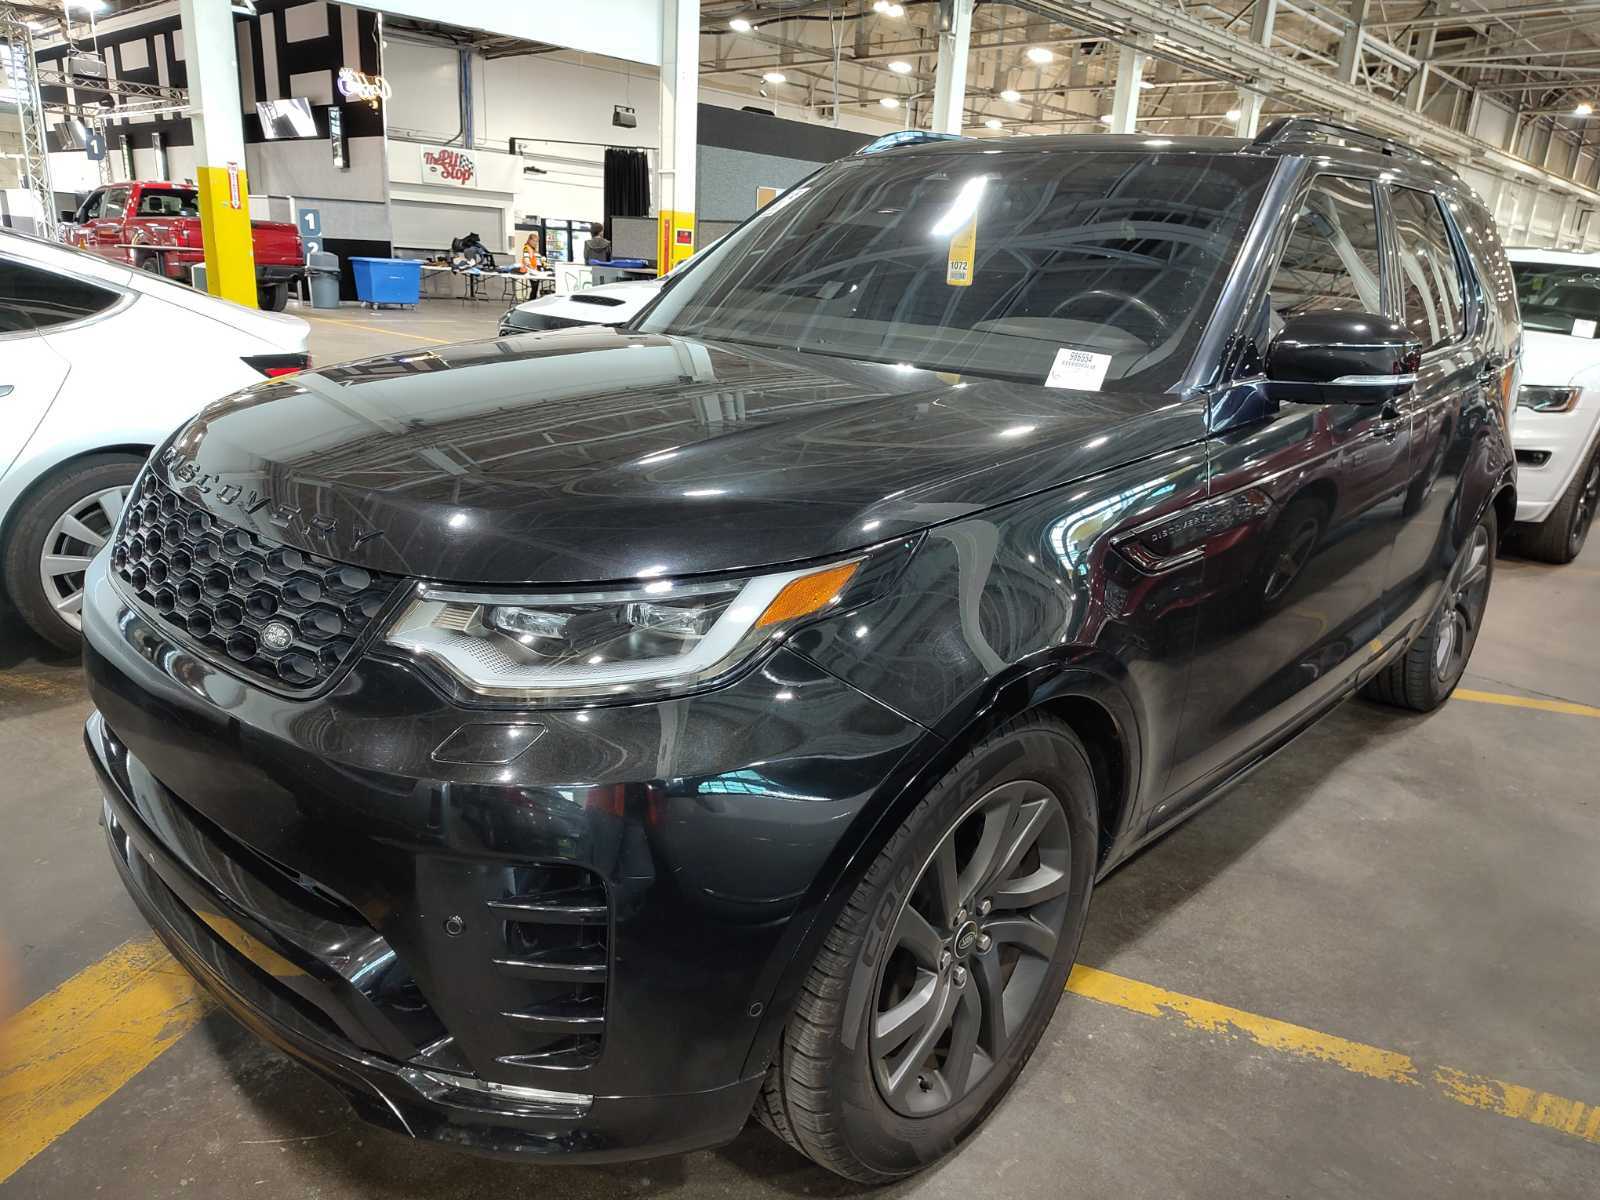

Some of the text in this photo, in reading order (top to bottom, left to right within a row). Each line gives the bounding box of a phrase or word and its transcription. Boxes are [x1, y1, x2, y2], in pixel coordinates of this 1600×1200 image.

[90, 139, 99, 154] 1
[423, 149, 459, 167] The Pit
[440, 163, 473, 185] Stop
[304, 213, 315, 230] 1
[307, 241, 319, 256] 2
[951, 261, 968, 271] 1072
[161, 446, 384, 551] DISCOVERY
